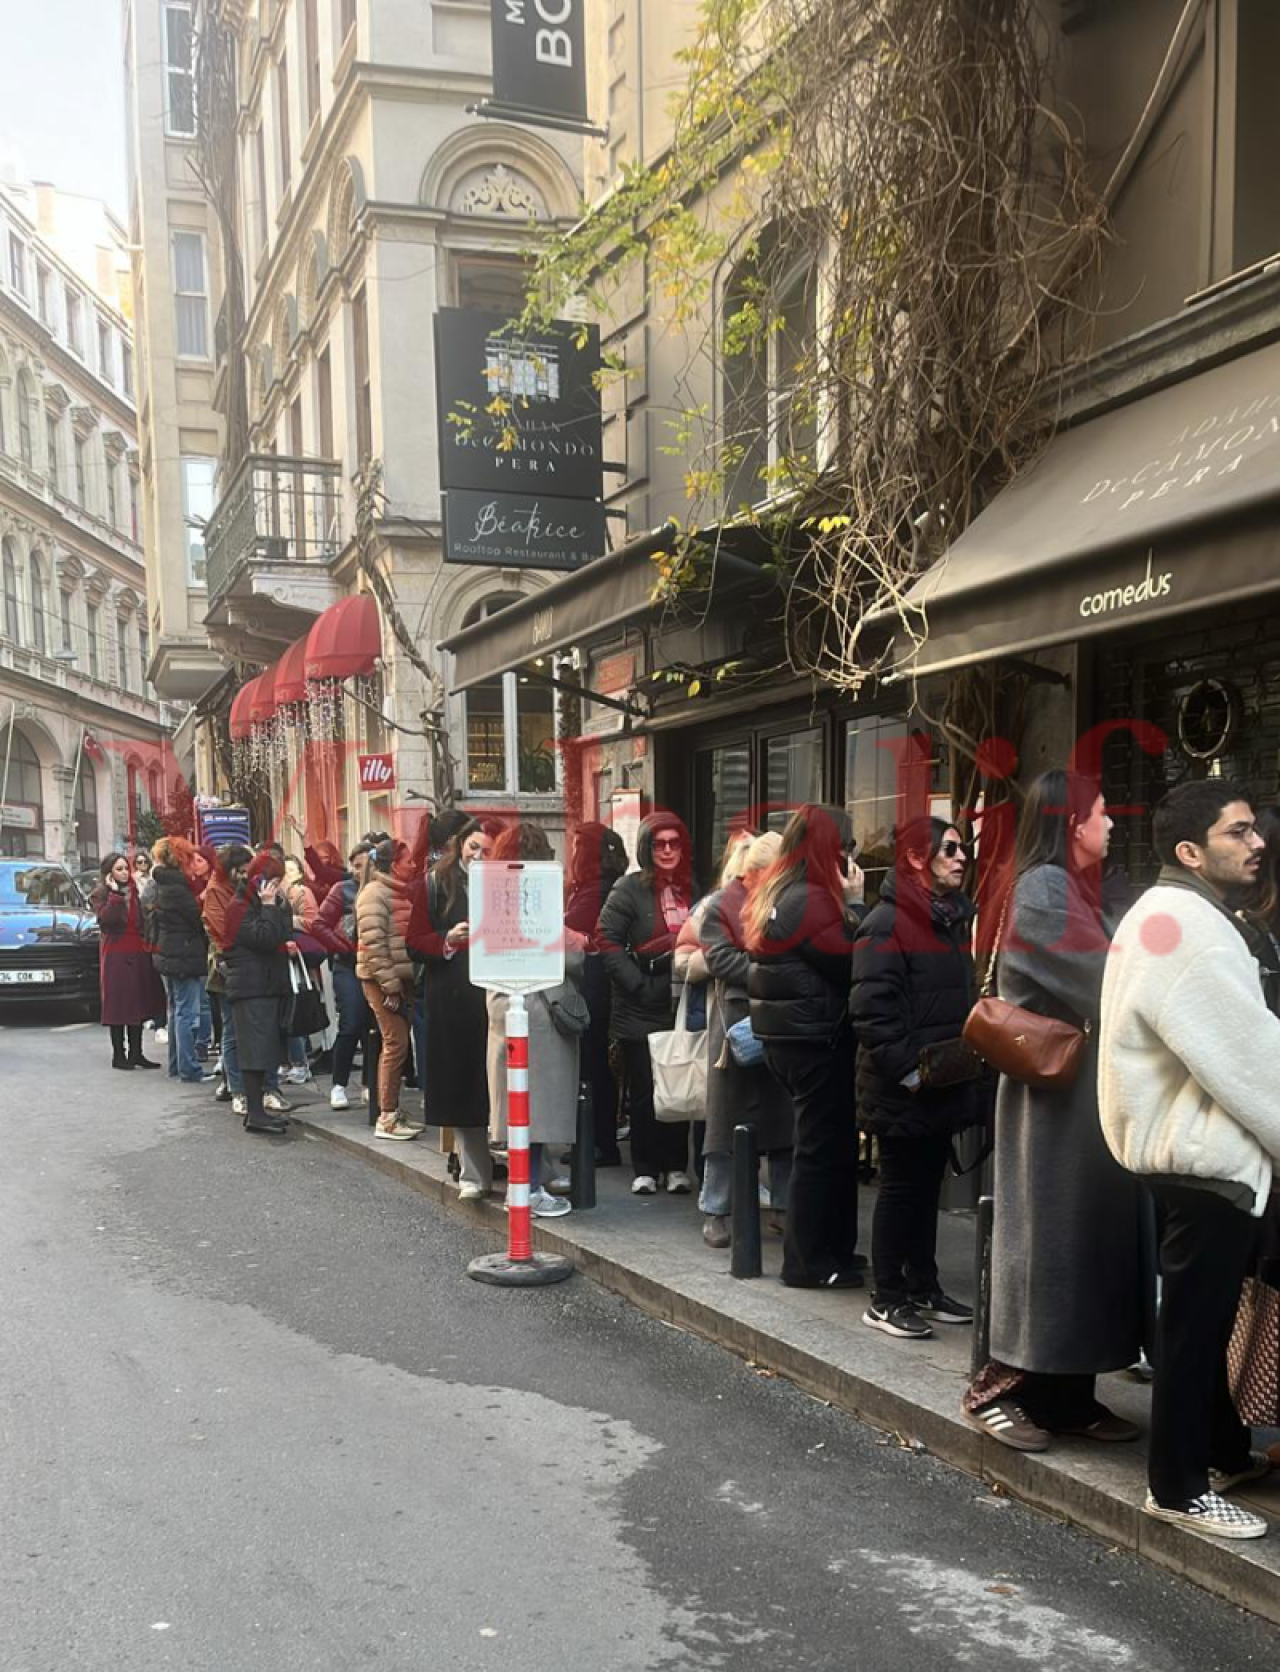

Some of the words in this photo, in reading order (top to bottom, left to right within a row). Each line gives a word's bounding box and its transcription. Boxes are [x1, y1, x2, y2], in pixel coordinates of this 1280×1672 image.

[494, 457, 556, 473] PERA
[1118, 453, 1243, 511] PERA
[452, 542, 502, 557] Rooftop
[504, 546, 566, 561] Restaurant
[1079, 546, 1174, 617] comedus
[362, 757, 392, 783] illy
